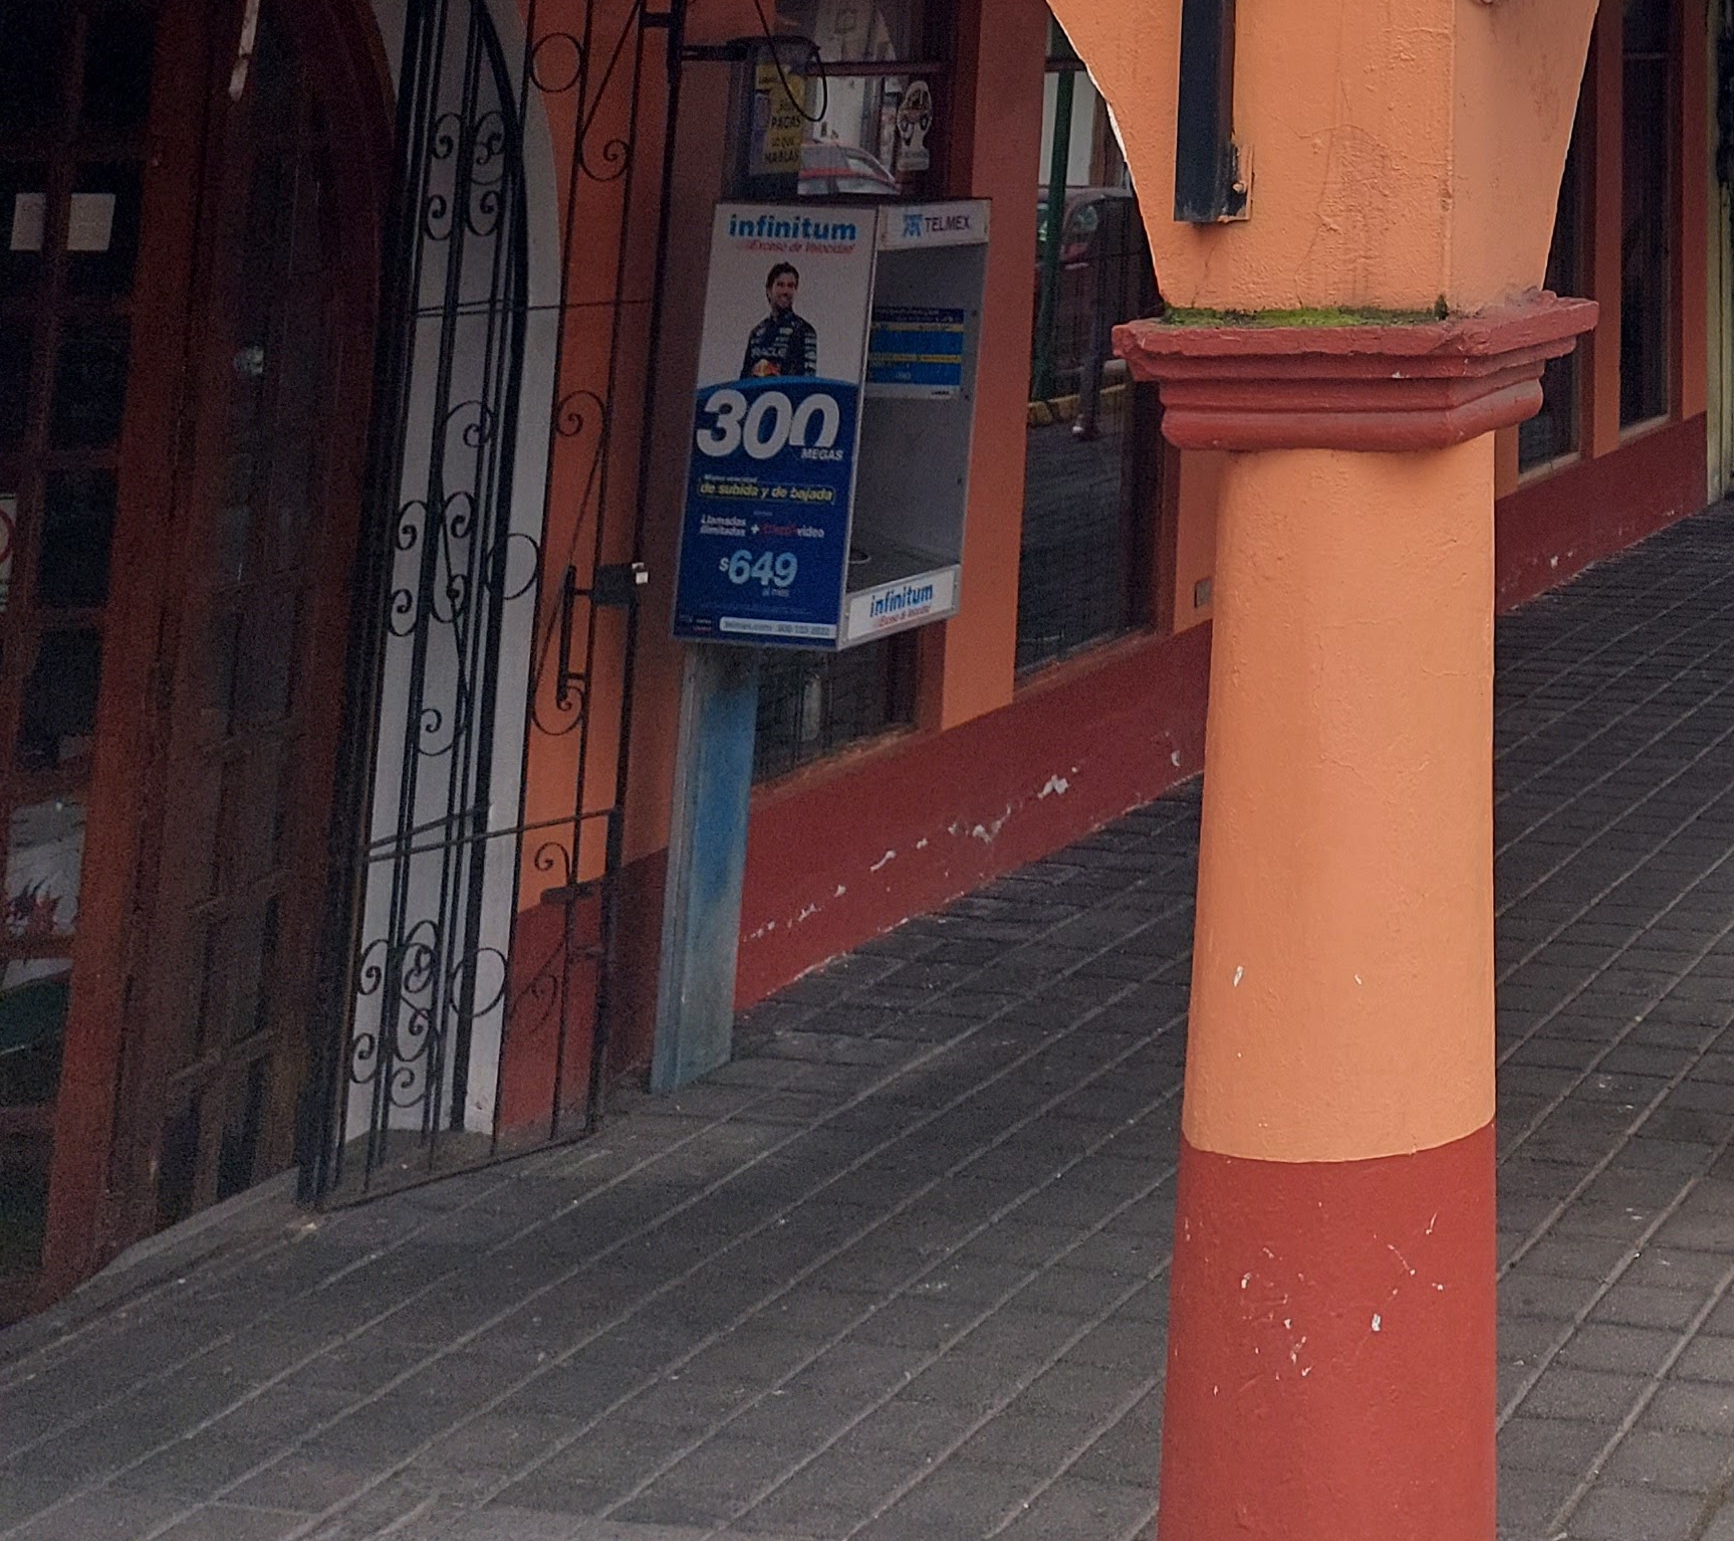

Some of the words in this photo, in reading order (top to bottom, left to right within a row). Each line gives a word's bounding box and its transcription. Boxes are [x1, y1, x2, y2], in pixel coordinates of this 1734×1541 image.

[728, 214, 857, 241] infinitum
[925, 216, 971, 234] TELMEX
[696, 388, 840, 459] 300
[801, 447, 844, 462] MEGAS
[718, 549, 798, 588] $649
[869, 584, 934, 618] infinitum
